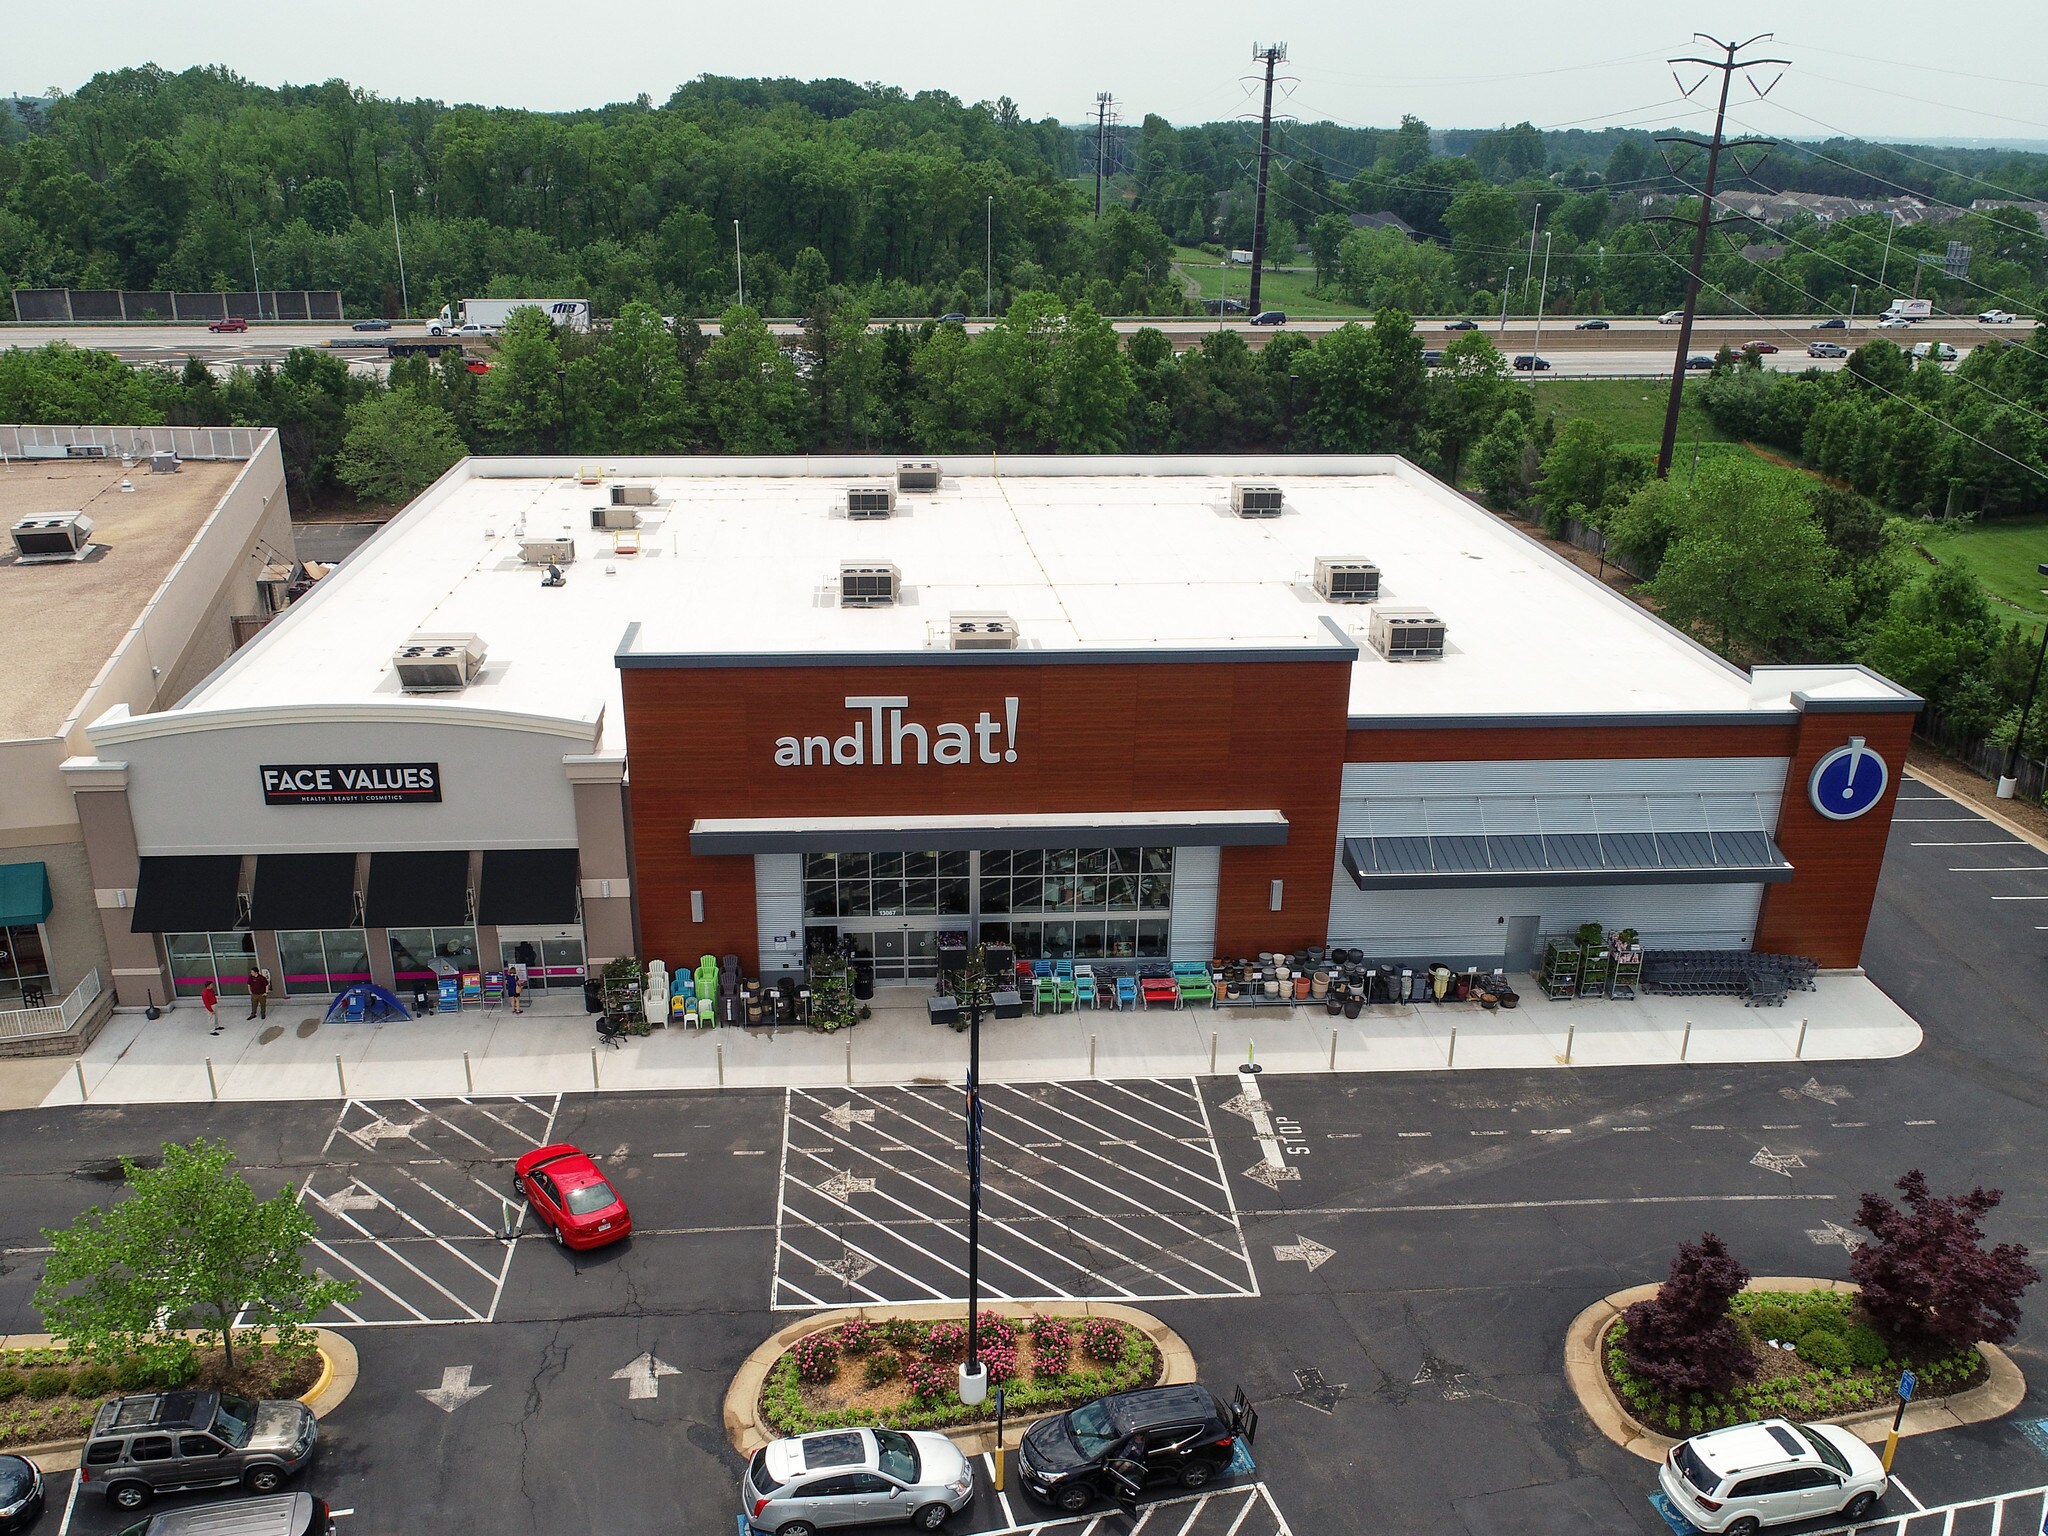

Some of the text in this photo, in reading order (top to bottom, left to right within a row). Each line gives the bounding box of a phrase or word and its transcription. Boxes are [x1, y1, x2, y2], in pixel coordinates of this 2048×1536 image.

[263, 768, 434, 791] FACE VALUES
[1275, 1116, 1311, 1155] STOP
